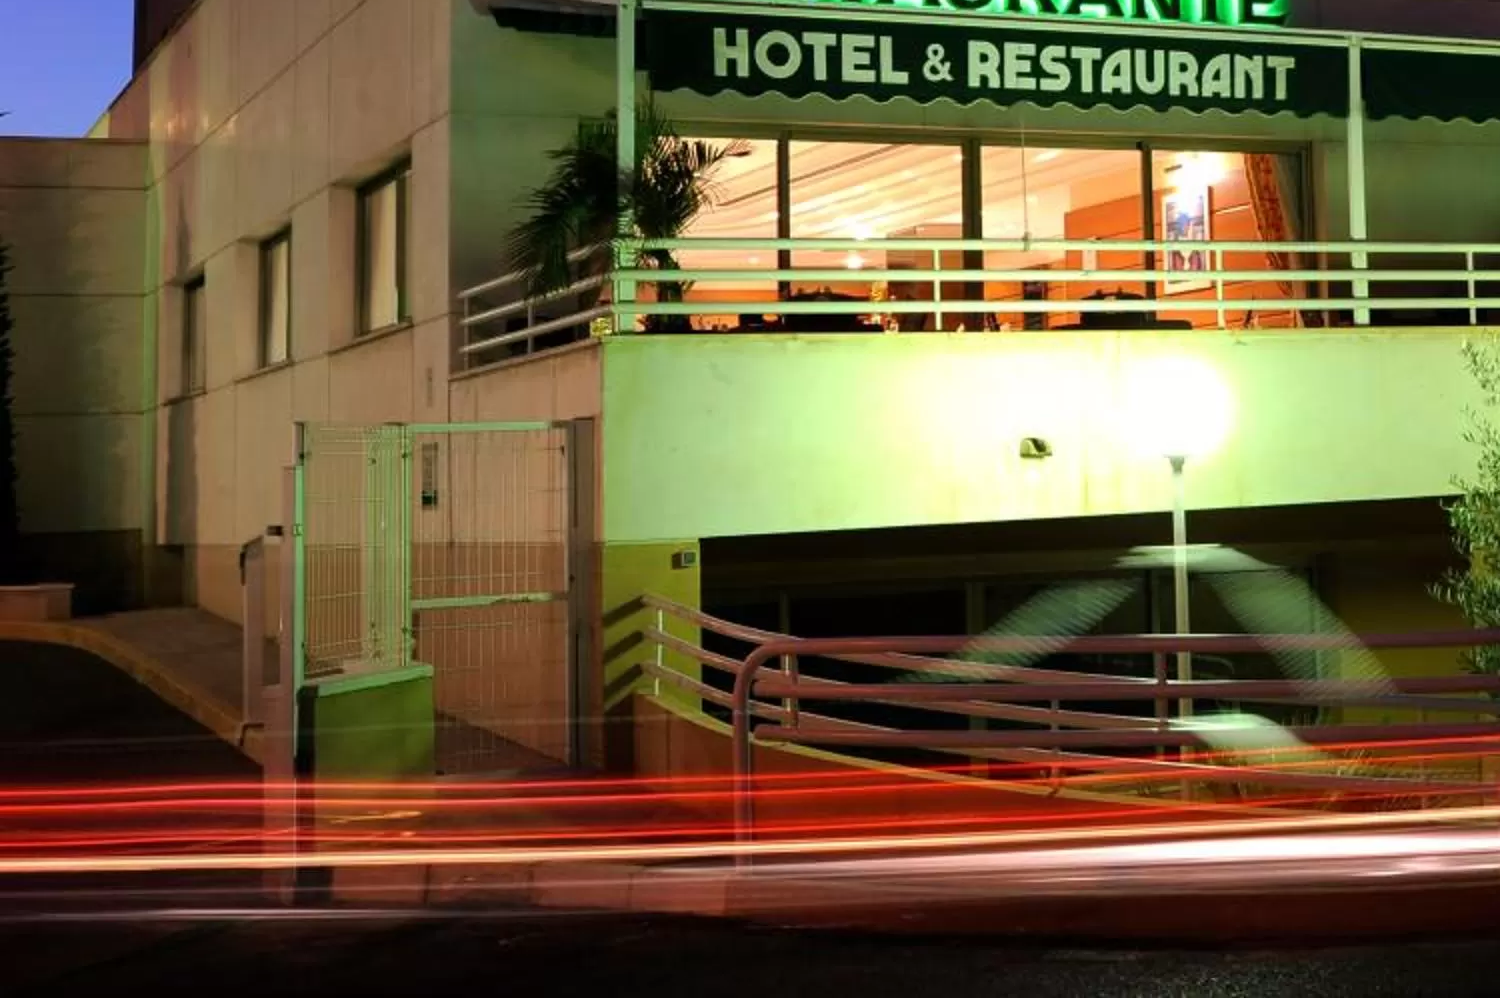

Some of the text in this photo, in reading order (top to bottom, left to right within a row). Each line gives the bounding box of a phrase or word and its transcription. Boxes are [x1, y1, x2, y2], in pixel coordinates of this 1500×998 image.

[712, 27, 1296, 101] HOTEL & RESTAURANT
